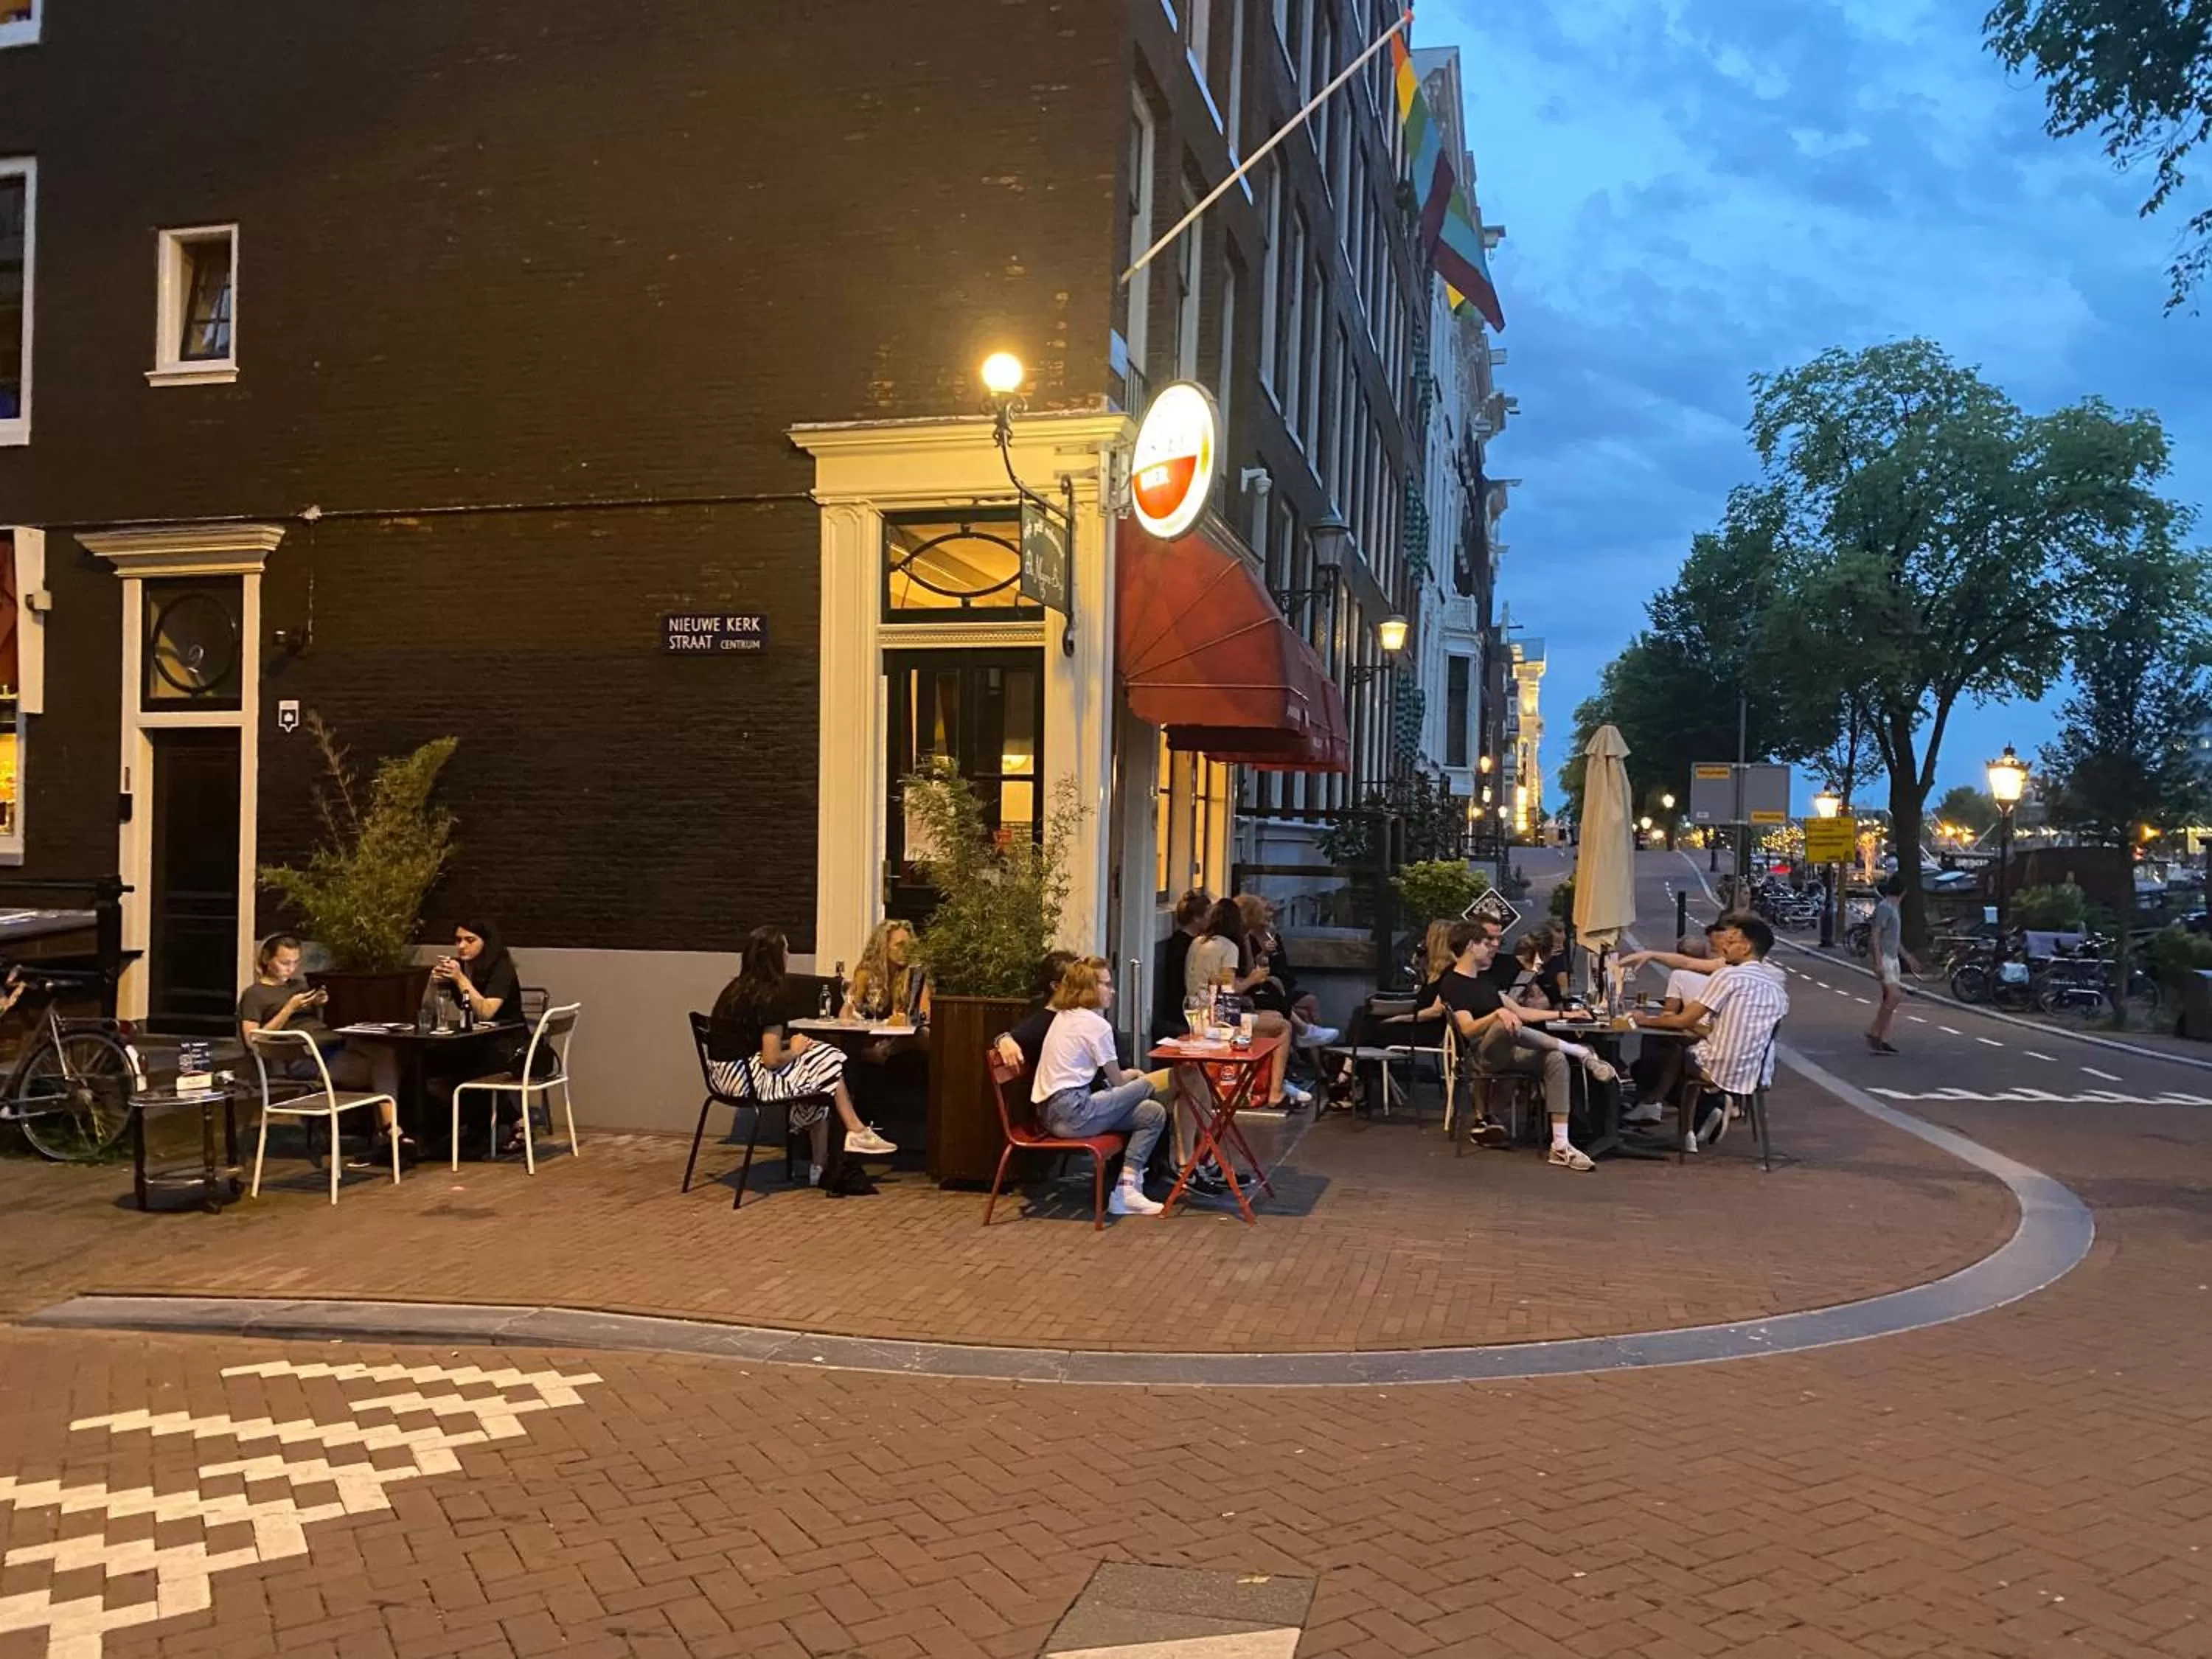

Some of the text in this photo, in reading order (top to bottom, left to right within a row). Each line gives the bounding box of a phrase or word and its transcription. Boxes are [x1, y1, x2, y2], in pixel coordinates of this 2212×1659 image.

[669, 617, 761, 632] NIEUWE KERK
[669, 635, 761, 650] STRAAT CENTRUM
